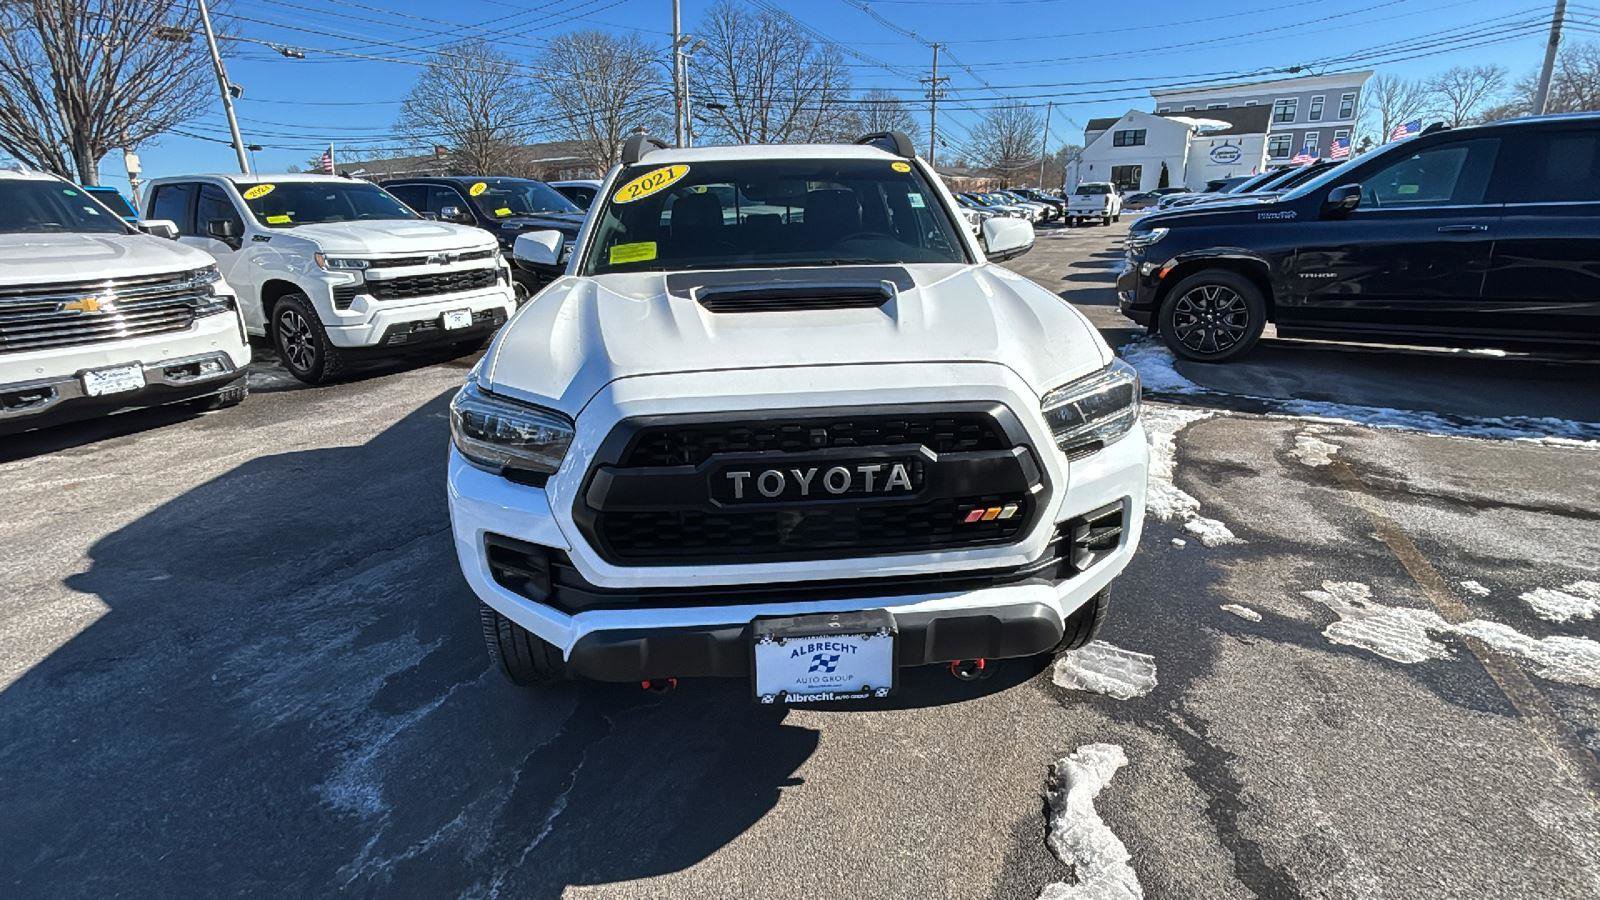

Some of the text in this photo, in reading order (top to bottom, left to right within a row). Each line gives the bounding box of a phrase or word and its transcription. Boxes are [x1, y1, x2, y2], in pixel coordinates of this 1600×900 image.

[628, 168, 676, 198] 2021
[726, 463, 913, 499] TOYOTA
[790, 641, 858, 659] ALBRECHT
[796, 674, 854, 684] AUTO GROUP
[784, 692, 834, 703] Albrecht
